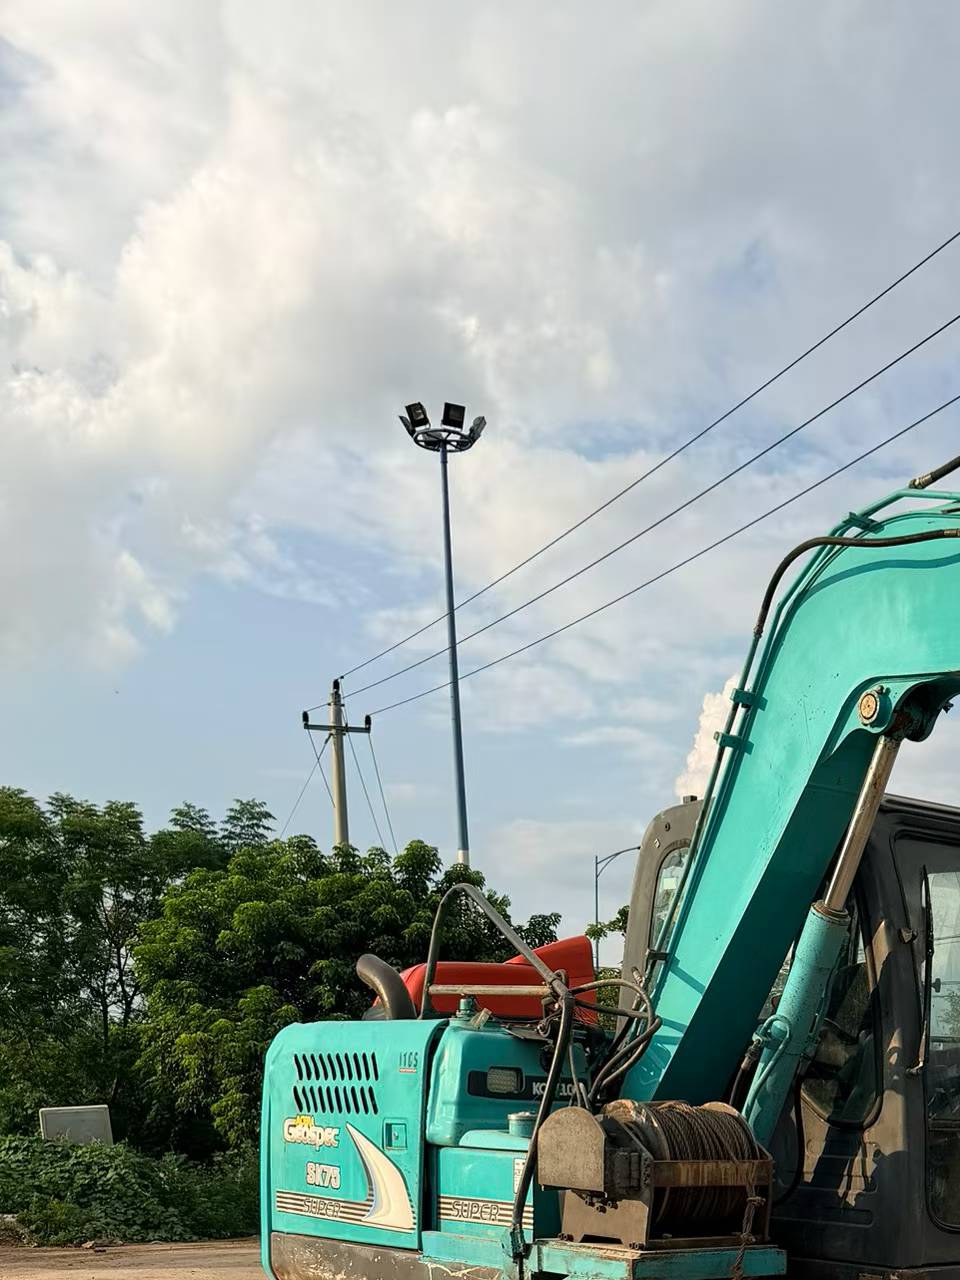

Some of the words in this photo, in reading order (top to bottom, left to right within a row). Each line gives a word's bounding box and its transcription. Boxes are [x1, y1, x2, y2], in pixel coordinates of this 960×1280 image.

[306, 1162, 341, 1189] SK75
[303, 1198, 341, 1218] SUPER
[452, 1200, 499, 1221] SUPER
